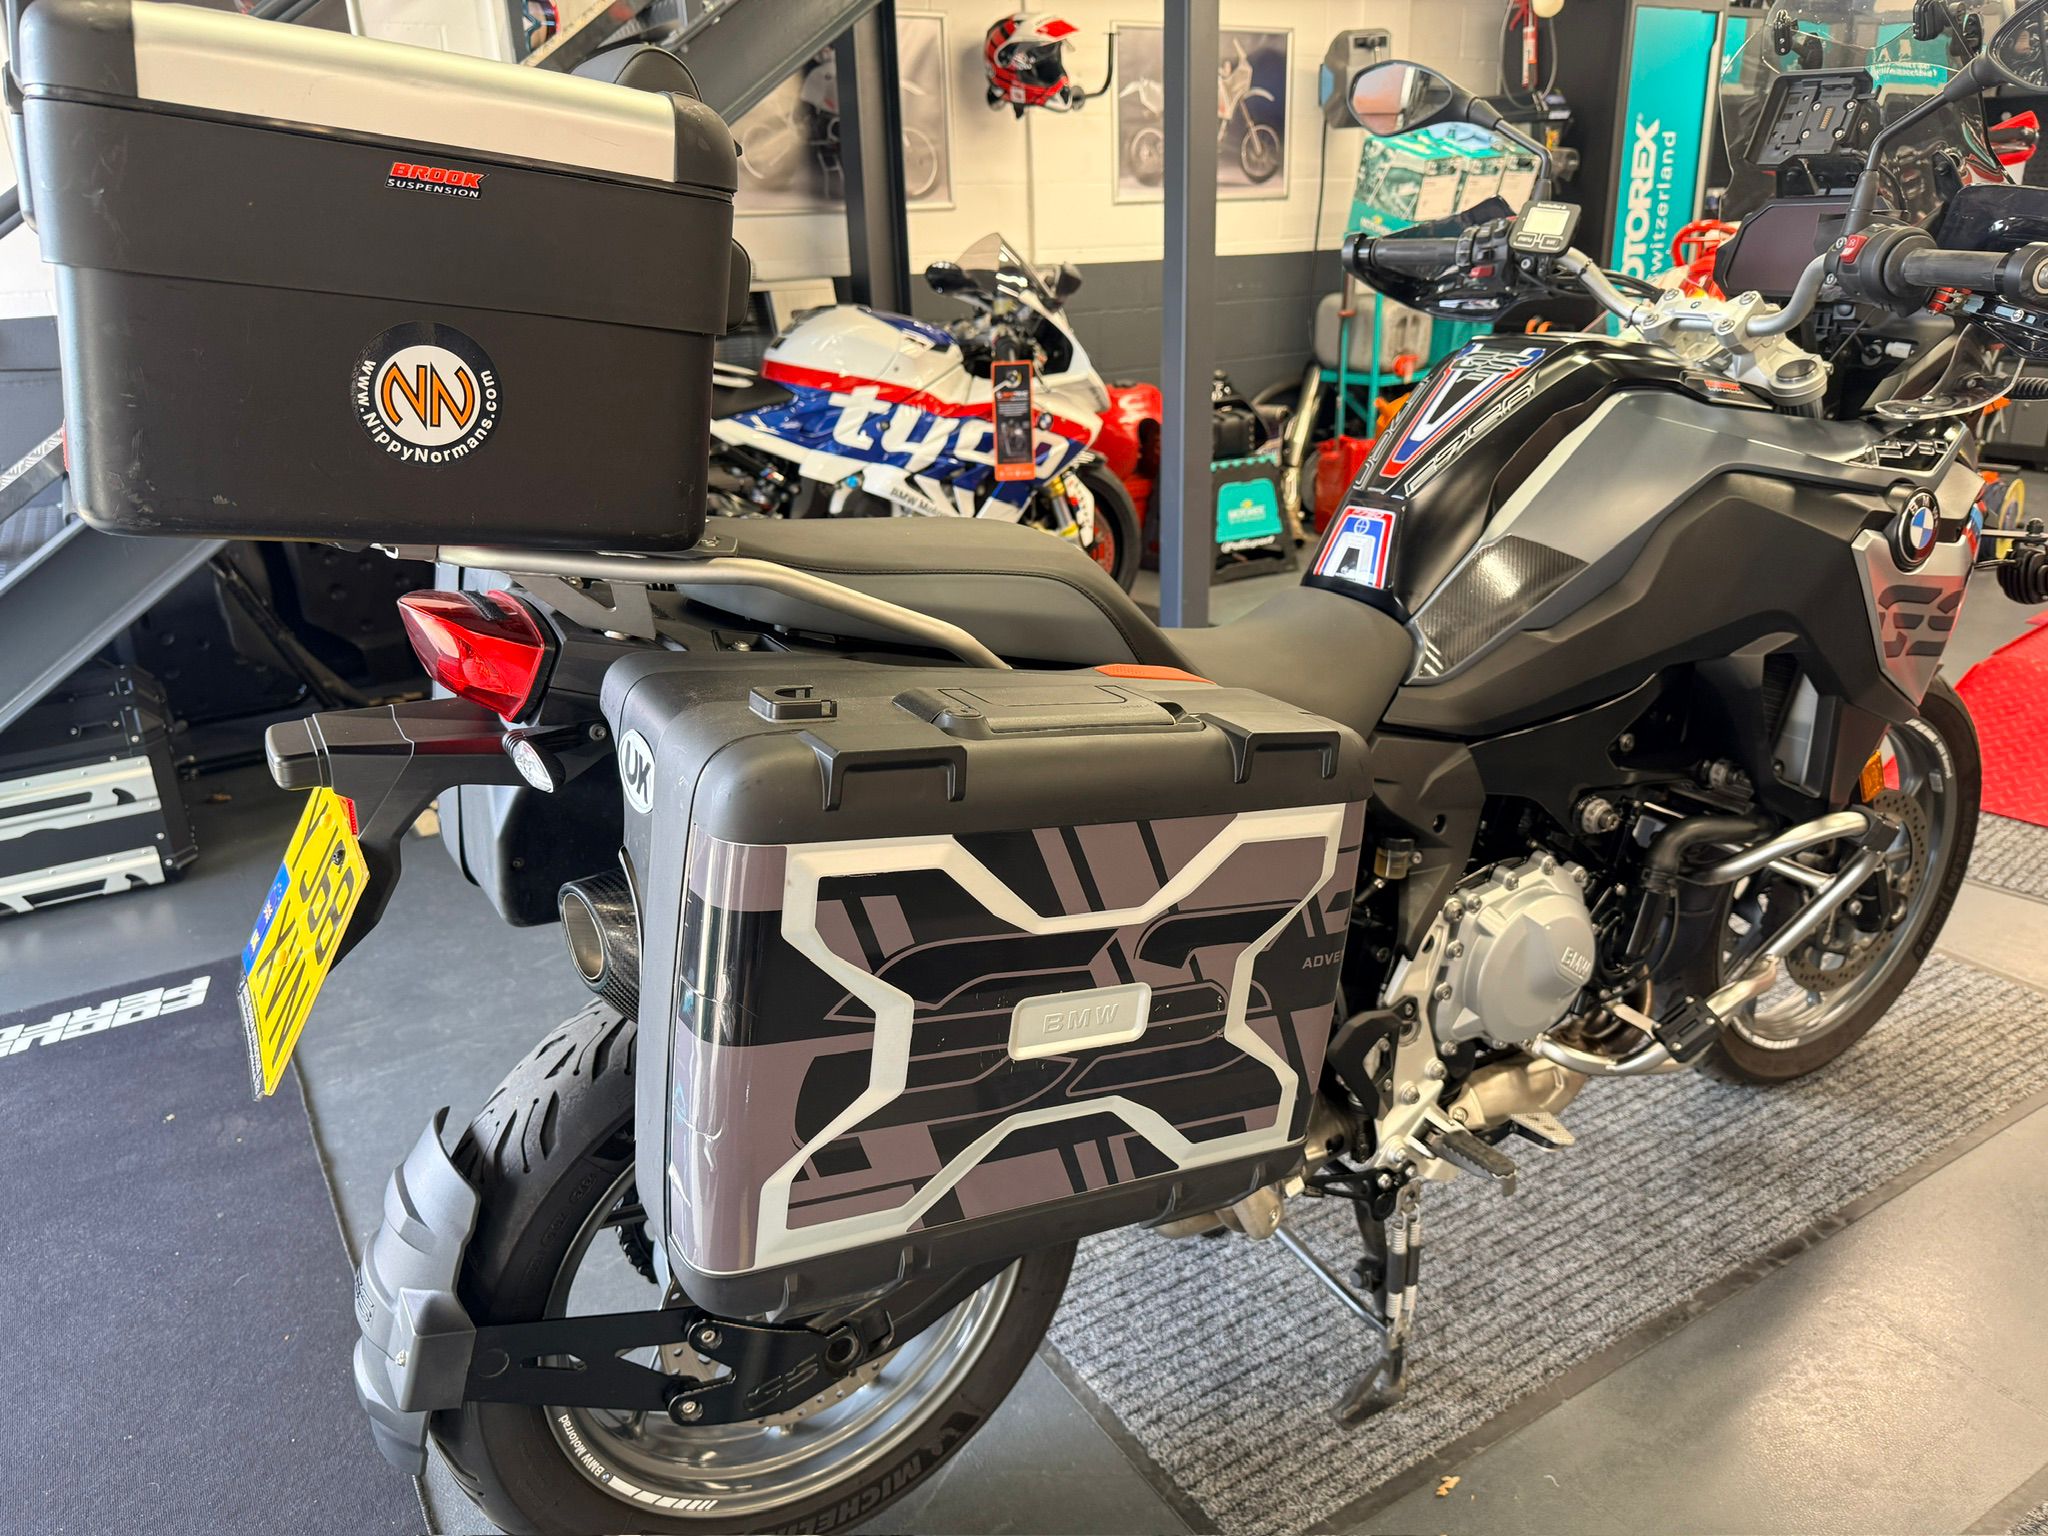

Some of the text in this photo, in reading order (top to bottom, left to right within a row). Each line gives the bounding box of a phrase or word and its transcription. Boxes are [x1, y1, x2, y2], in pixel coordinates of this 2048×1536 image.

[387, 179, 479, 198] SUSPENSION
[390, 162, 485, 189] BROOK
[1650, 131, 1677, 278] witzerland
[357, 360, 498, 464] www.NippyNormans.com
[625, 740, 651, 804] UK
[291, 787, 354, 966] YJ68
[256, 897, 309, 1069] XVN
[1302, 952, 1331, 970] ADVE
[0, 988, 208, 1058] FOCU
[1043, 1003, 1119, 1034] BMW
[558, 1414, 606, 1477] BMW Motorrad
